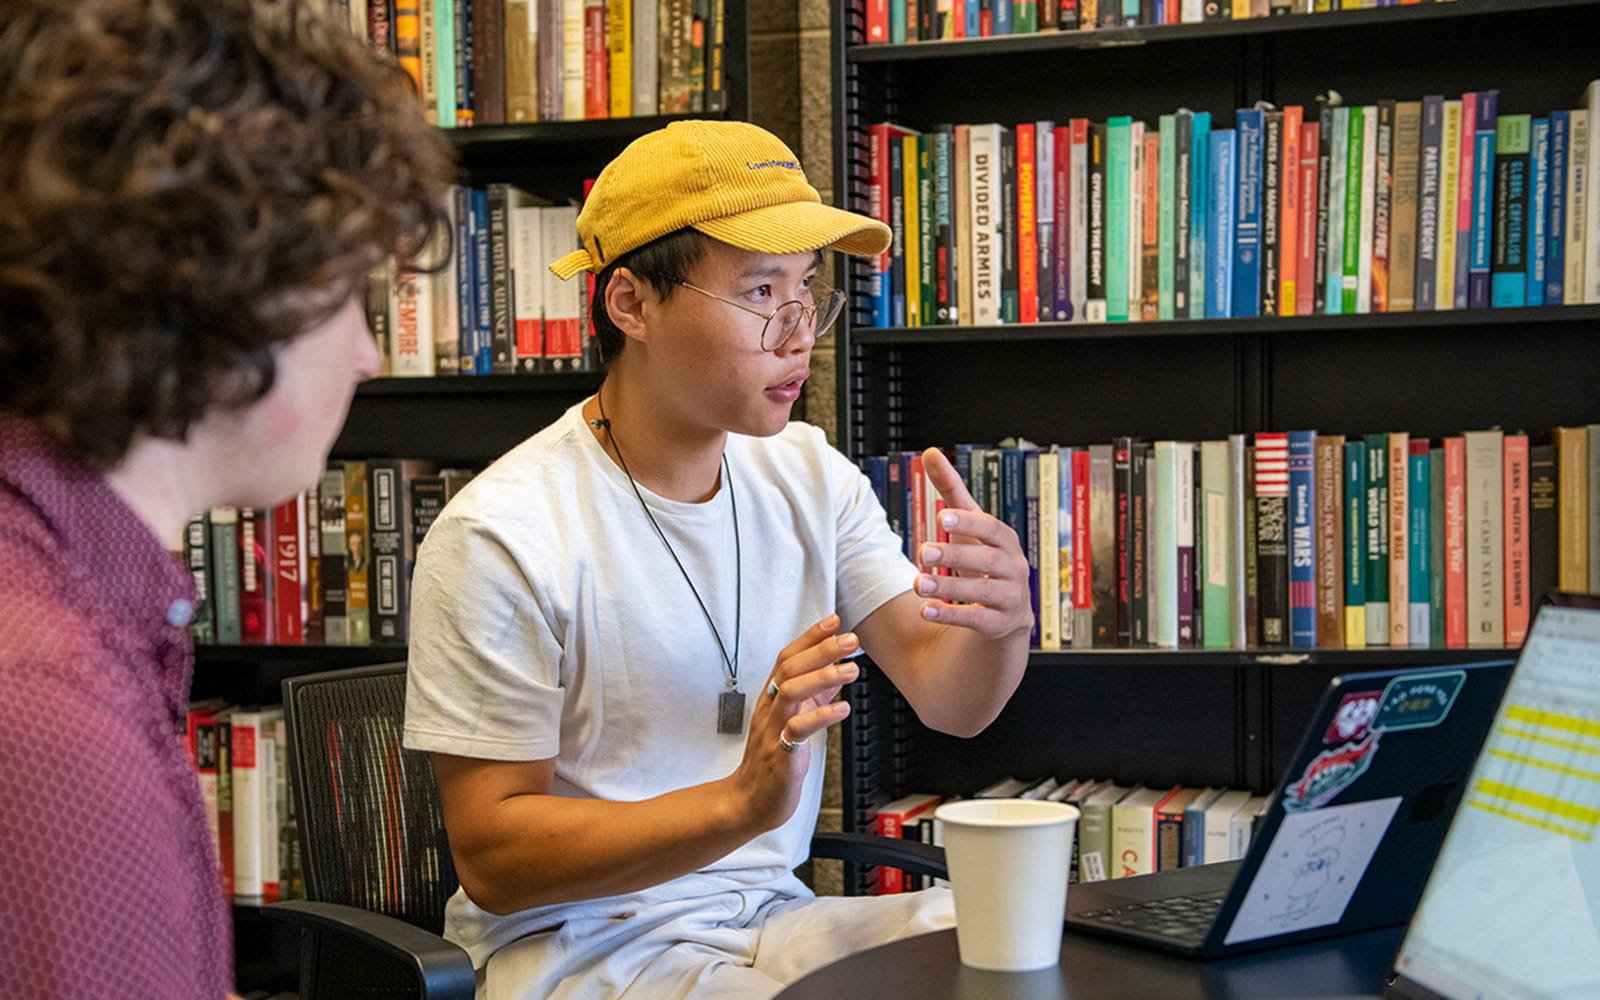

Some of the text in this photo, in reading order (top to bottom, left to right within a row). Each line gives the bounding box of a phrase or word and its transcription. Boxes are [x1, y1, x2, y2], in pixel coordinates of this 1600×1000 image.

[1267, 121, 1278, 160] STATES
[1378, 125, 1391, 153] FREE
[1267, 163, 1277, 187] AND
[1377, 154, 1390, 193] TRADE
[1020, 163, 1032, 235] POWERFUL
[1266, 189, 1276, 244] MARKETS
[1421, 146, 1438, 261] PARTIAL HEGEMONY
[1444, 172, 1455, 243] HEGEMONY
[1508, 161, 1524, 264] GLOBAL CAPITALISM
[975, 154, 991, 299] DIVIDED ARMIES
[1092, 172, 1101, 285] CIVILIZING THE ENEMY
[1376, 231, 1388, 258] FIRE
[1022, 236, 1034, 293] PATRIOTS
[494, 285, 507, 339] ALLIANCE
[1324, 445, 1335, 512] MOBILIZING
[1077, 499, 1085, 529] Political
[1258, 498, 1271, 542] OF WAR
[1270, 497, 1284, 541] WAGES
[1293, 484, 1311, 567] Taxing WARS
[1324, 514, 1335, 536] FOR
[1368, 488, 1379, 527] WORLD
[1447, 485, 1463, 546] Supplying
[279, 534, 297, 582] 1917
[1077, 530, 1086, 561] Economy
[1368, 528, 1379, 553] WAR
[1481, 519, 1491, 555] CASH
[1325, 538, 1336, 586] MODERN
[1452, 549, 1463, 572] War
[1078, 570, 1086, 604] Terrorism
[1482, 560, 1491, 607] NEXUS
